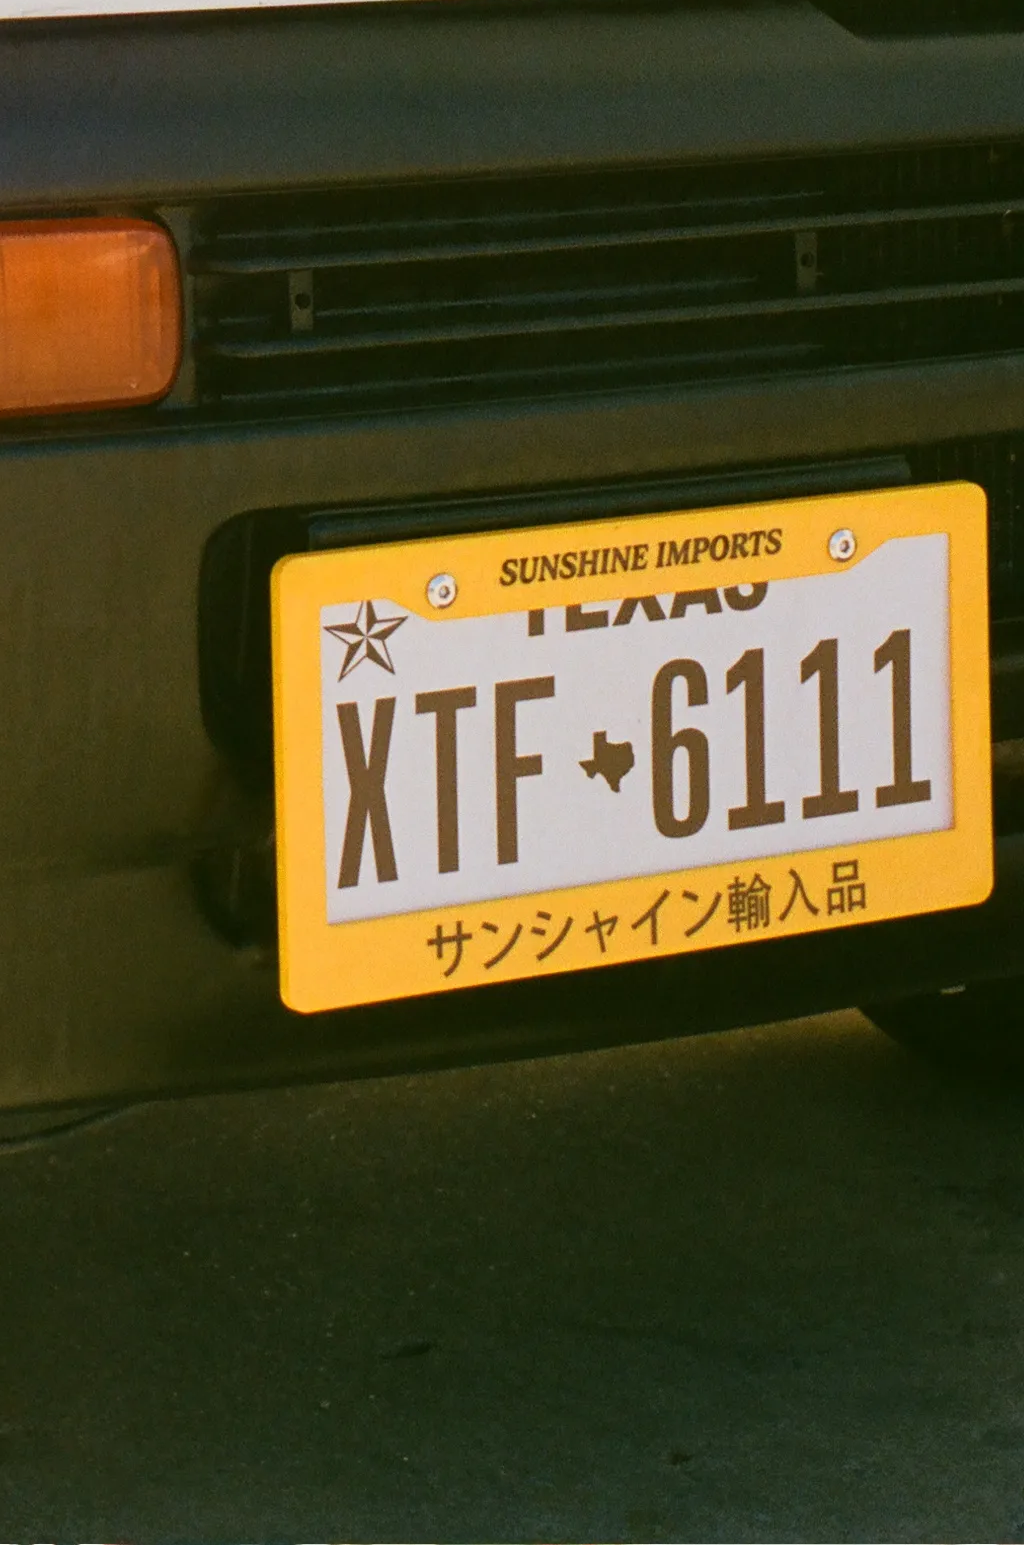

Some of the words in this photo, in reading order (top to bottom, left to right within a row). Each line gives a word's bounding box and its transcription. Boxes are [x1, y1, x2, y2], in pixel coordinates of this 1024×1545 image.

[499, 543, 650, 587] SUNSHINE
[655, 527, 784, 569] IMPORTS
[335, 674, 556, 890] XTF
[650, 627, 932, 840] 6111
[426, 858, 868, 979] サンシャイン輸入品
